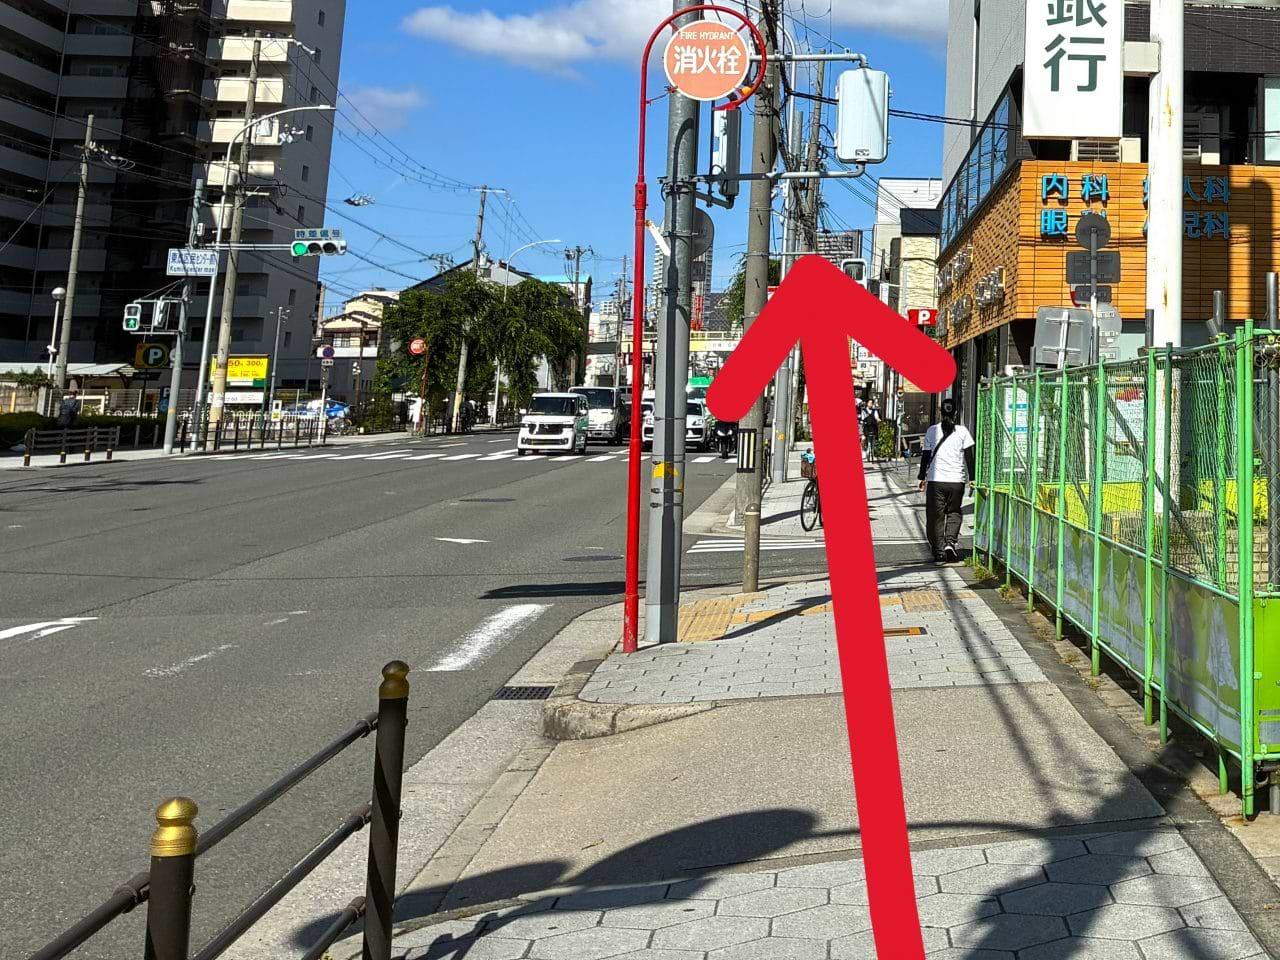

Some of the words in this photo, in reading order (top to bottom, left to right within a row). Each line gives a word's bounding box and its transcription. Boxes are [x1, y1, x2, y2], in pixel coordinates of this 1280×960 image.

[680, 31, 697, 40] FIRE
[699, 31, 735, 41] HYDRANT
[673, 45, 742, 75] 消火栓
[1041, 172, 1109, 202] 内科
[1143, 174, 1231, 204] 人科
[1143, 210, 1232, 240] 児科
[918, 310, 931, 325] P
[149, 352, 163, 364] P
